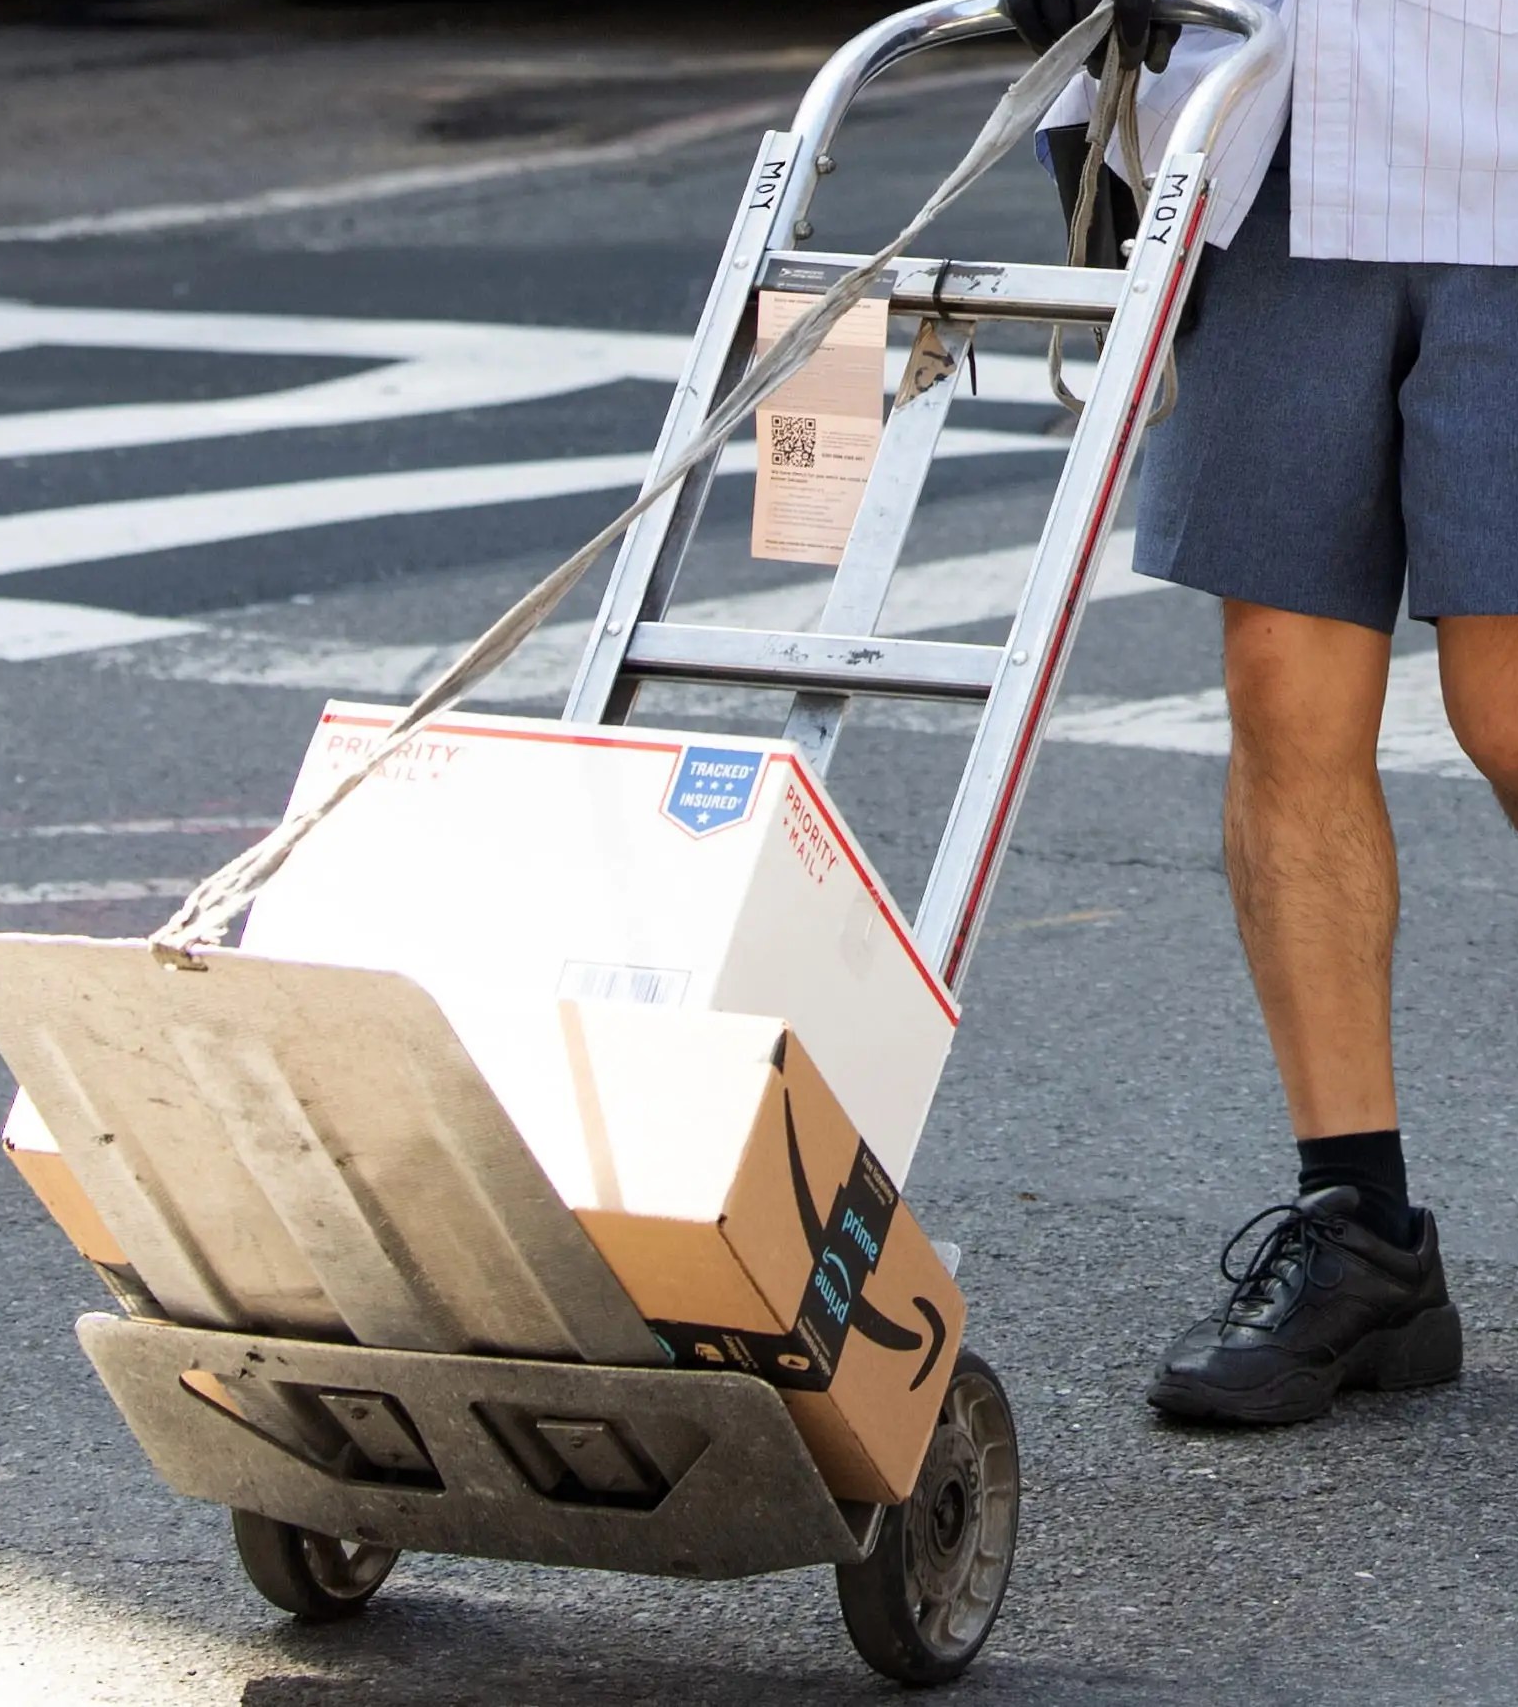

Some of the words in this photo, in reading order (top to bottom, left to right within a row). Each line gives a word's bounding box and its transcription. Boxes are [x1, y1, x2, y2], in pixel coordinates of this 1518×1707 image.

[749, 161, 786, 210] MOY
[1146, 174, 1189, 245] MOY
[690, 761, 751, 780] TRACKED
[679, 792, 740, 810] INSURED
[785, 784, 838, 872] PRIORITY
[789, 829, 815, 878] MAIL
[842, 1207, 879, 1263] prime
[814, 1266, 850, 1326] prime
